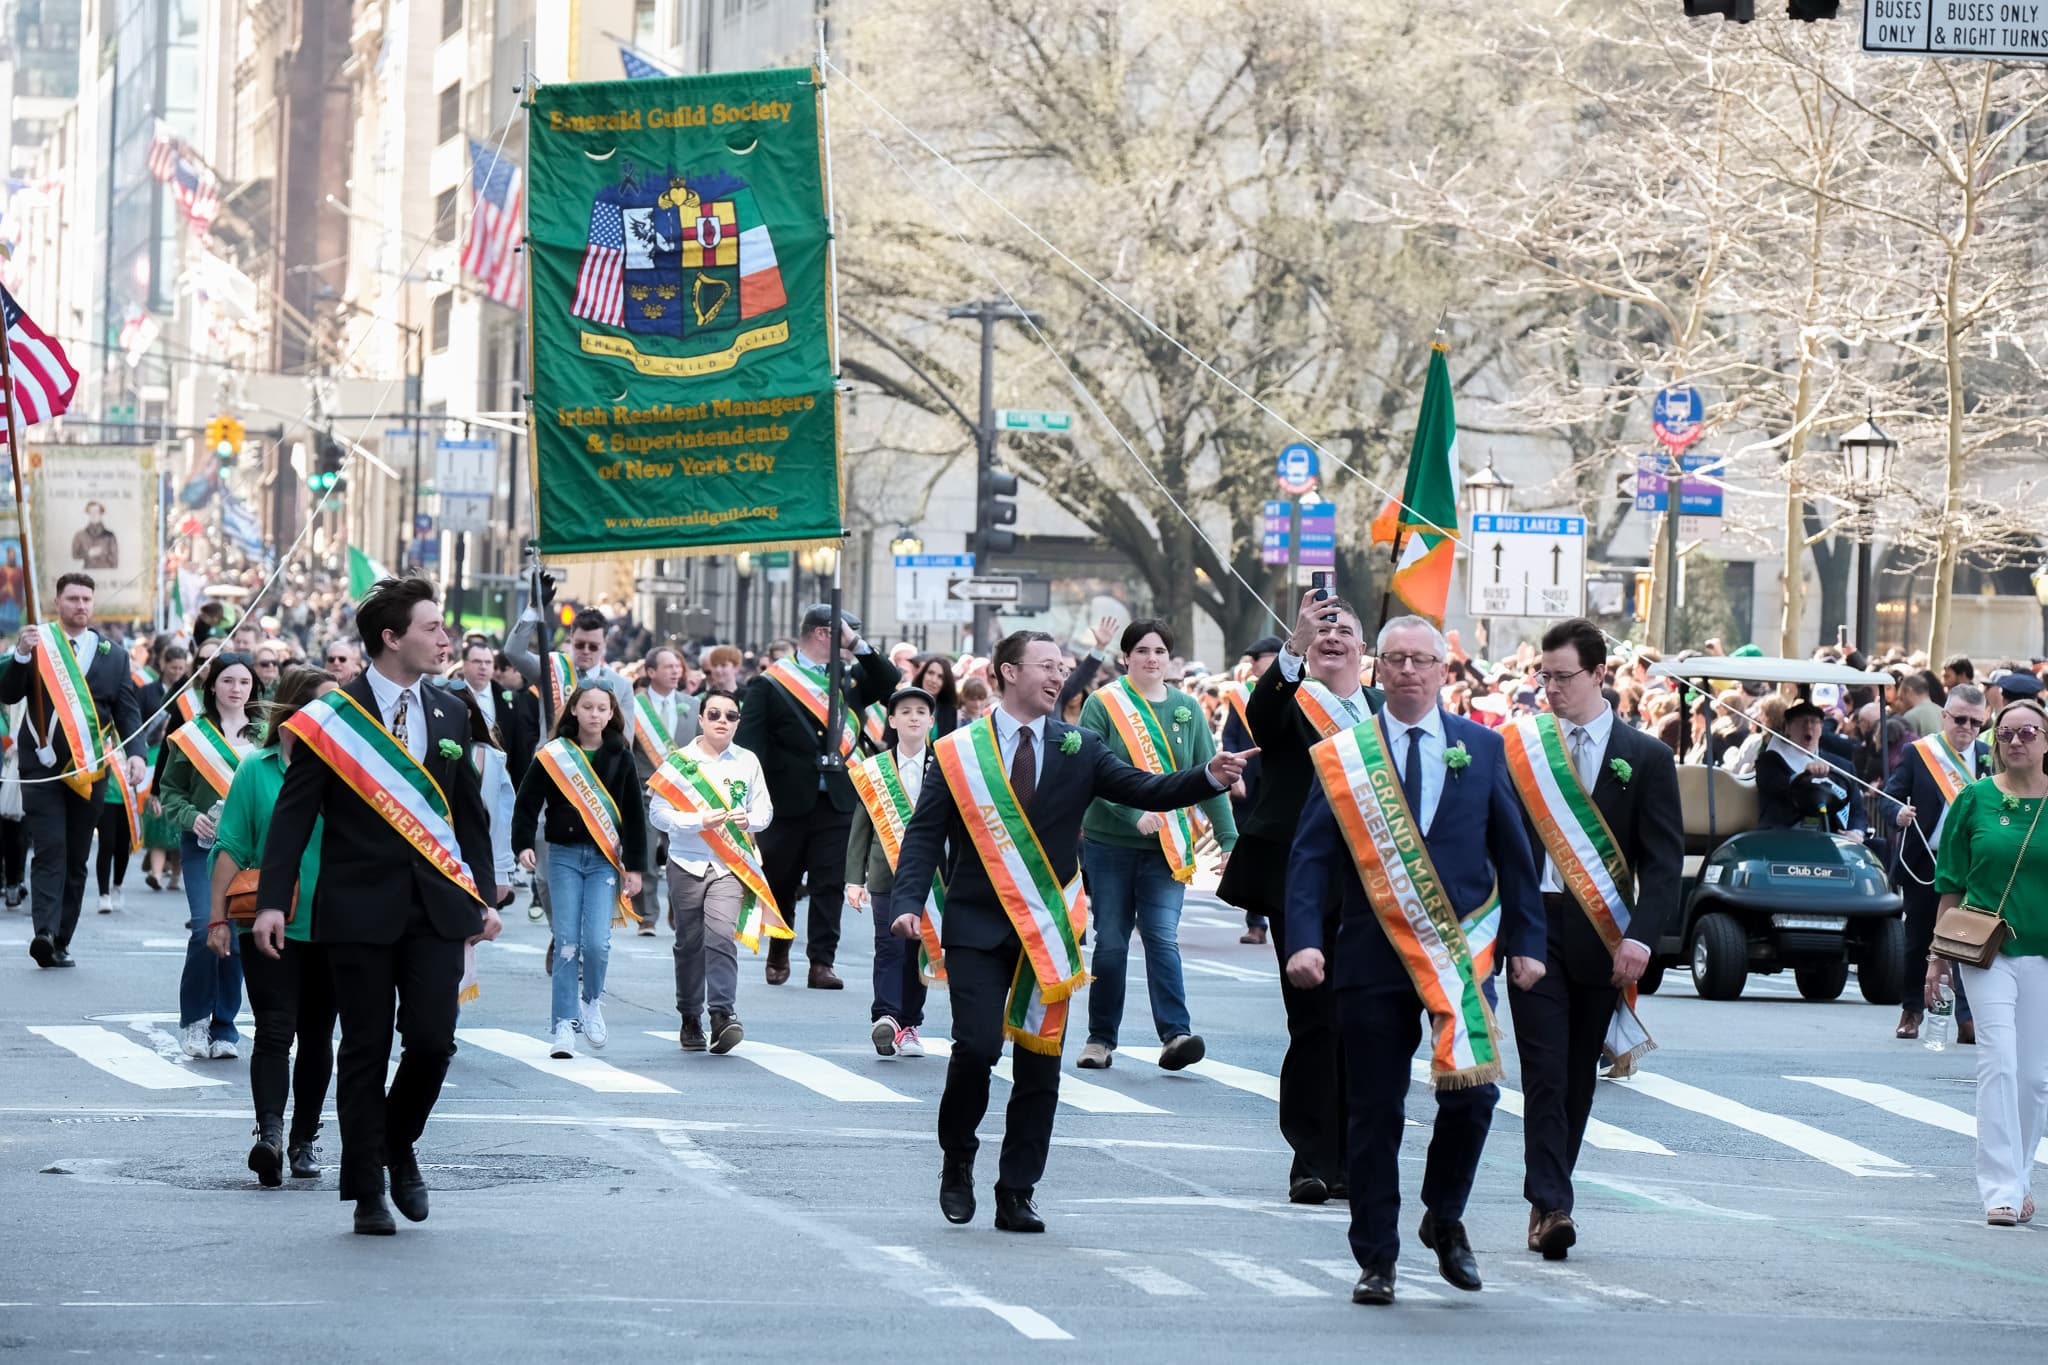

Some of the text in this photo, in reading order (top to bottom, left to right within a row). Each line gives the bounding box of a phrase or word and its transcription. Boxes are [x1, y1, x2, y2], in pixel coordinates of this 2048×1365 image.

[1875, 0, 1922, 20] BUSES
[1947, 3, 2039, 24] BUSES ONLY
[1878, 24, 1916, 43] ONLY
[1934, 26, 2048, 48] & RIGHT TURNS
[550, 101, 792, 132] Emerald Guild Society
[558, 395, 815, 428] Irish Resident Managers
[586, 423, 790, 454] & Superintendents
[598, 452, 776, 480] of New York City
[604, 504, 778, 529] www.emeraldguild.org
[1495, 517, 1561, 534] BUS LANES
[50, 649, 77, 707] MARSHAL
[571, 773, 611, 831] EMERALD
[371, 789, 458, 874] EMERALD
[979, 805, 1016, 855] AIDE
[1353, 781, 1450, 970] EMERALD GUILD
[1371, 769, 1468, 966] GRAND MARSHAL
[1541, 815, 1604, 912] EMERALD
[1787, 865, 1833, 877] Club Car
